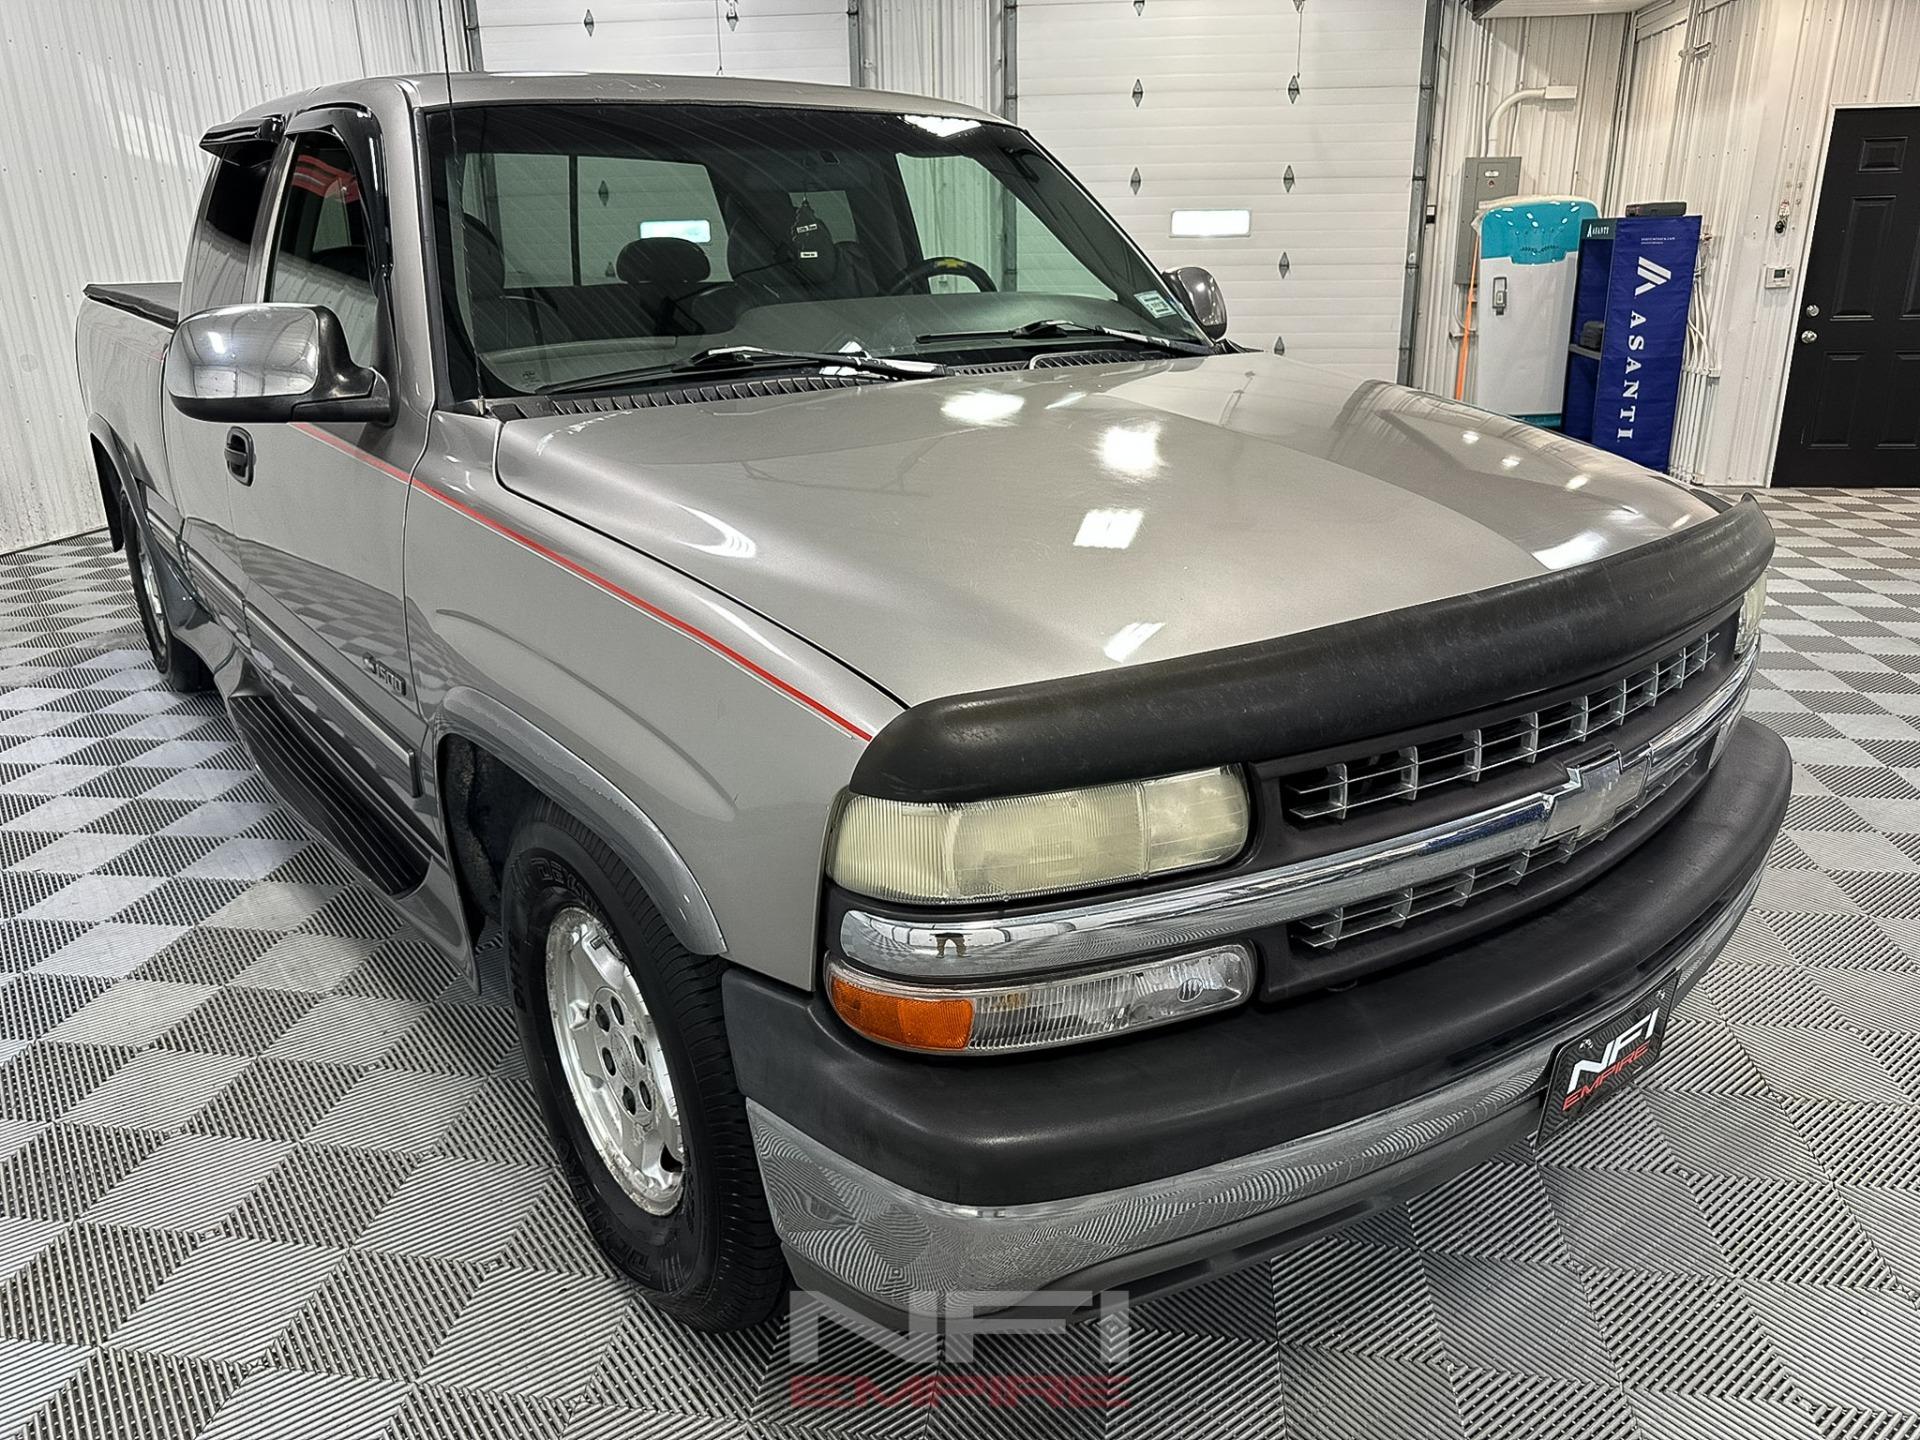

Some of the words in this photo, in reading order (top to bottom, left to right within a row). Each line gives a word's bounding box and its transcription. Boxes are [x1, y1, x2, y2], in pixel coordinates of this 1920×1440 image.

[1617, 310, 1648, 439] ASANTI
[1562, 1040, 1650, 1111] EMPIRE
[1567, 1007, 1660, 1094] NFI
